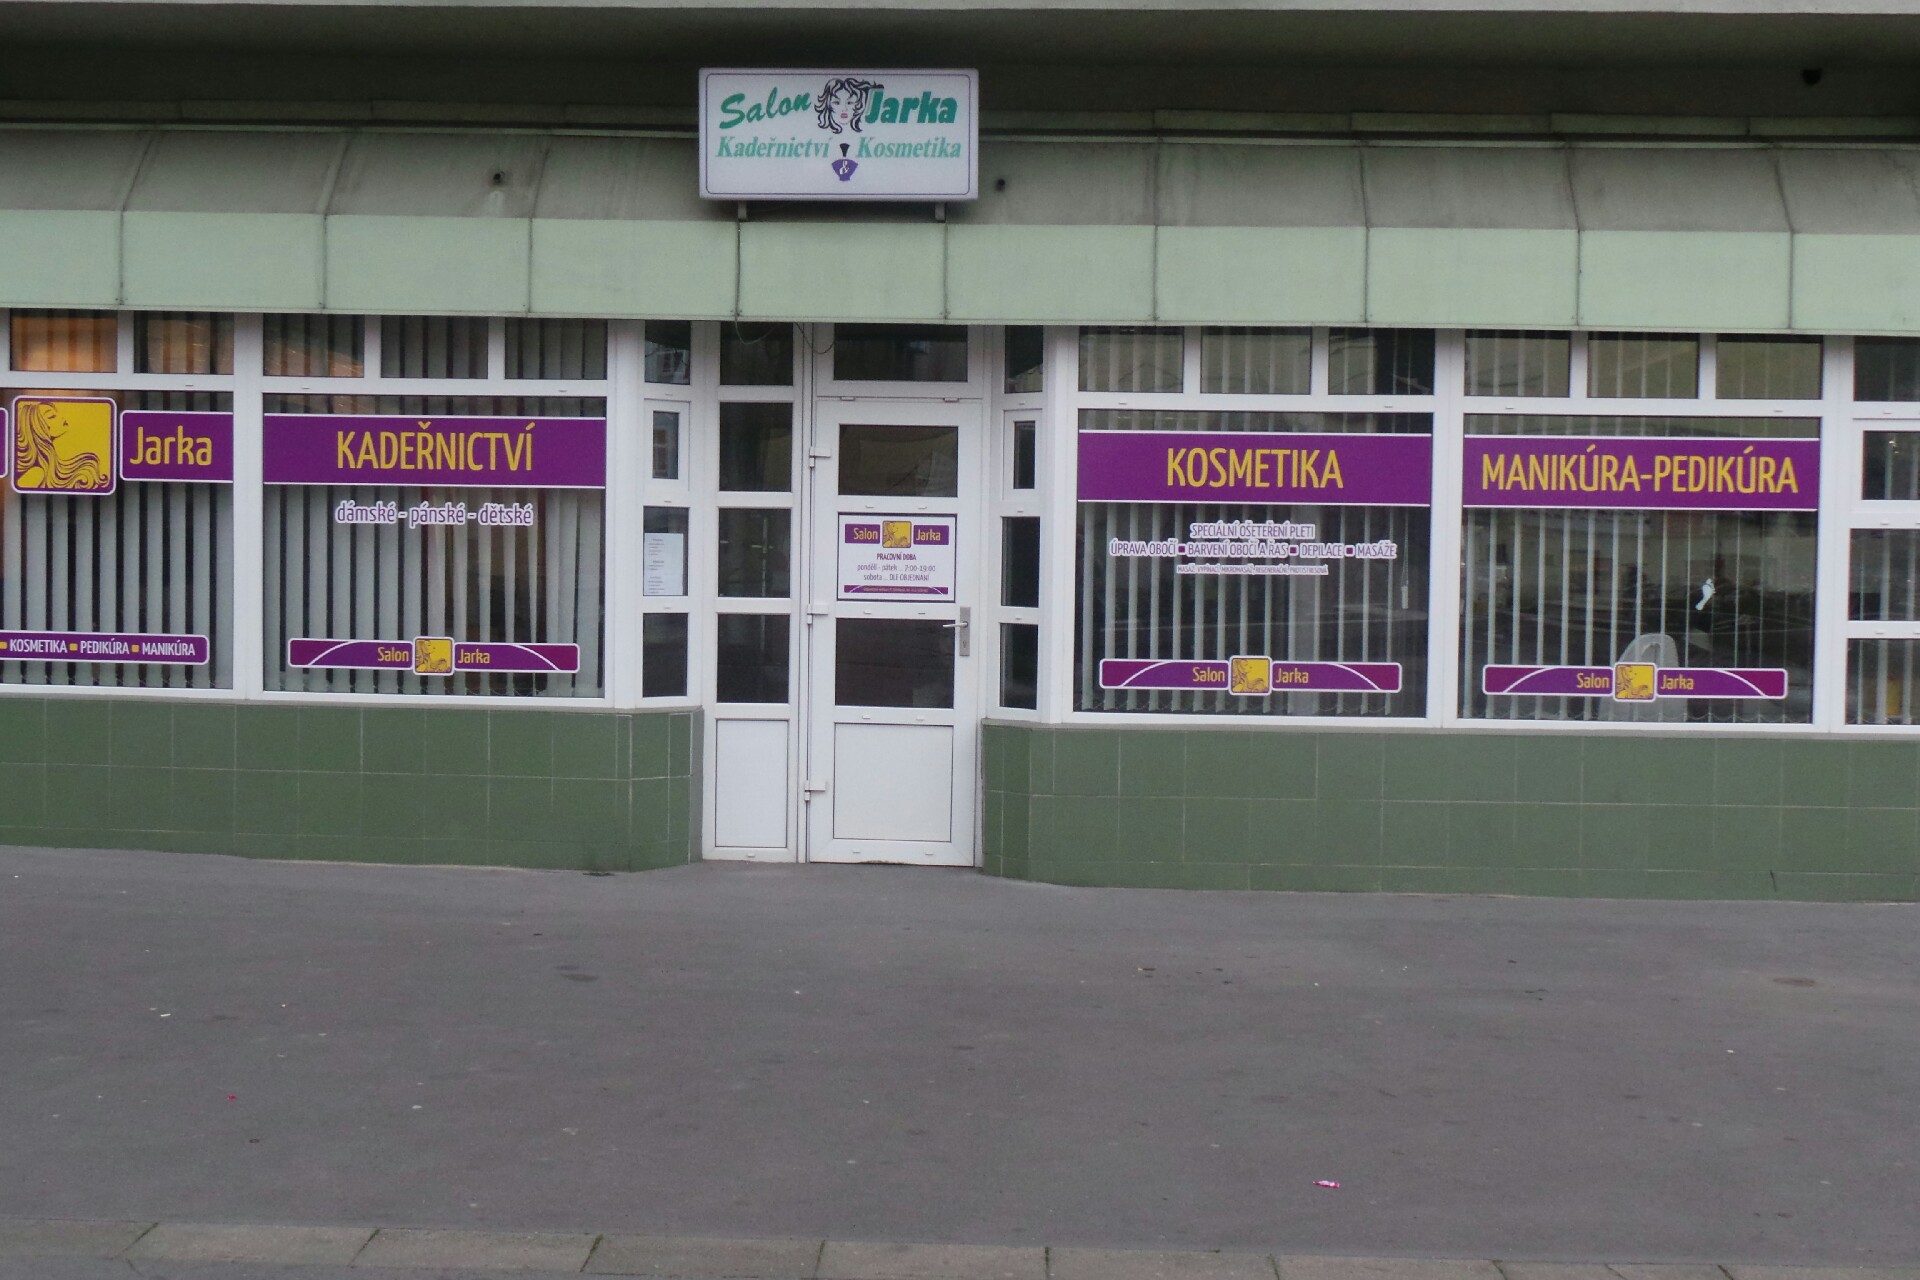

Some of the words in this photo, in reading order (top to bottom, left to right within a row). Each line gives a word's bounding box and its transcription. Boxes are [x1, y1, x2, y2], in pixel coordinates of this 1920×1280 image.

[719, 87, 812, 129] Salon
[865, 88, 958, 124] Jarka
[715, 136, 833, 158] Kadeřnictví
[855, 136, 962, 158] Kosmetika
[130, 425, 213, 466] Jarka
[336, 421, 536, 471] KADEŘNICTVÍ
[1167, 447, 1344, 488] KOSMETIKA
[1482, 444, 1799, 494] MANIKÚRA-PEDIKÚRA
[337, 501, 397, 523] dámské
[410, 502, 465, 527] pánské
[479, 503, 533, 524] dětské
[853, 527, 878, 540] Salon
[915, 528, 941, 541] Jarka
[1191, 520, 1239, 537] SPECIÁLNÍ
[1290, 524, 1314, 538] PLETI
[876, 552, 902, 561] PRACOVNÍ
[902, 553, 917, 561] DOBA
[1111, 538, 1147, 555] ÚPRAVA
[1149, 538, 1177, 555] OBOČÍ
[1188, 539, 1229, 556] BARVENÍ
[1230, 539, 1259, 556] OBOČÍ
[1259, 543, 1265, 556] A
[1268, 539, 1287, 556] ŘAS
[1301, 544, 1342, 557] DEPILACE
[1357, 540, 1395, 557] MASÁŽE
[863, 572, 883, 581] sobota
[10, 639, 68, 653] KOSMETIKA
[80, 638, 130, 655] PEDIKÚRA
[142, 640, 195, 656] MANIKÚRA
[377, 647, 409, 662] Salon
[457, 648, 490, 664] Jarka
[1192, 666, 1225, 682] Salon
[1275, 668, 1309, 684] Jarka
[1576, 672, 1609, 689] Salon
[1660, 673, 1694, 690] Jarka
